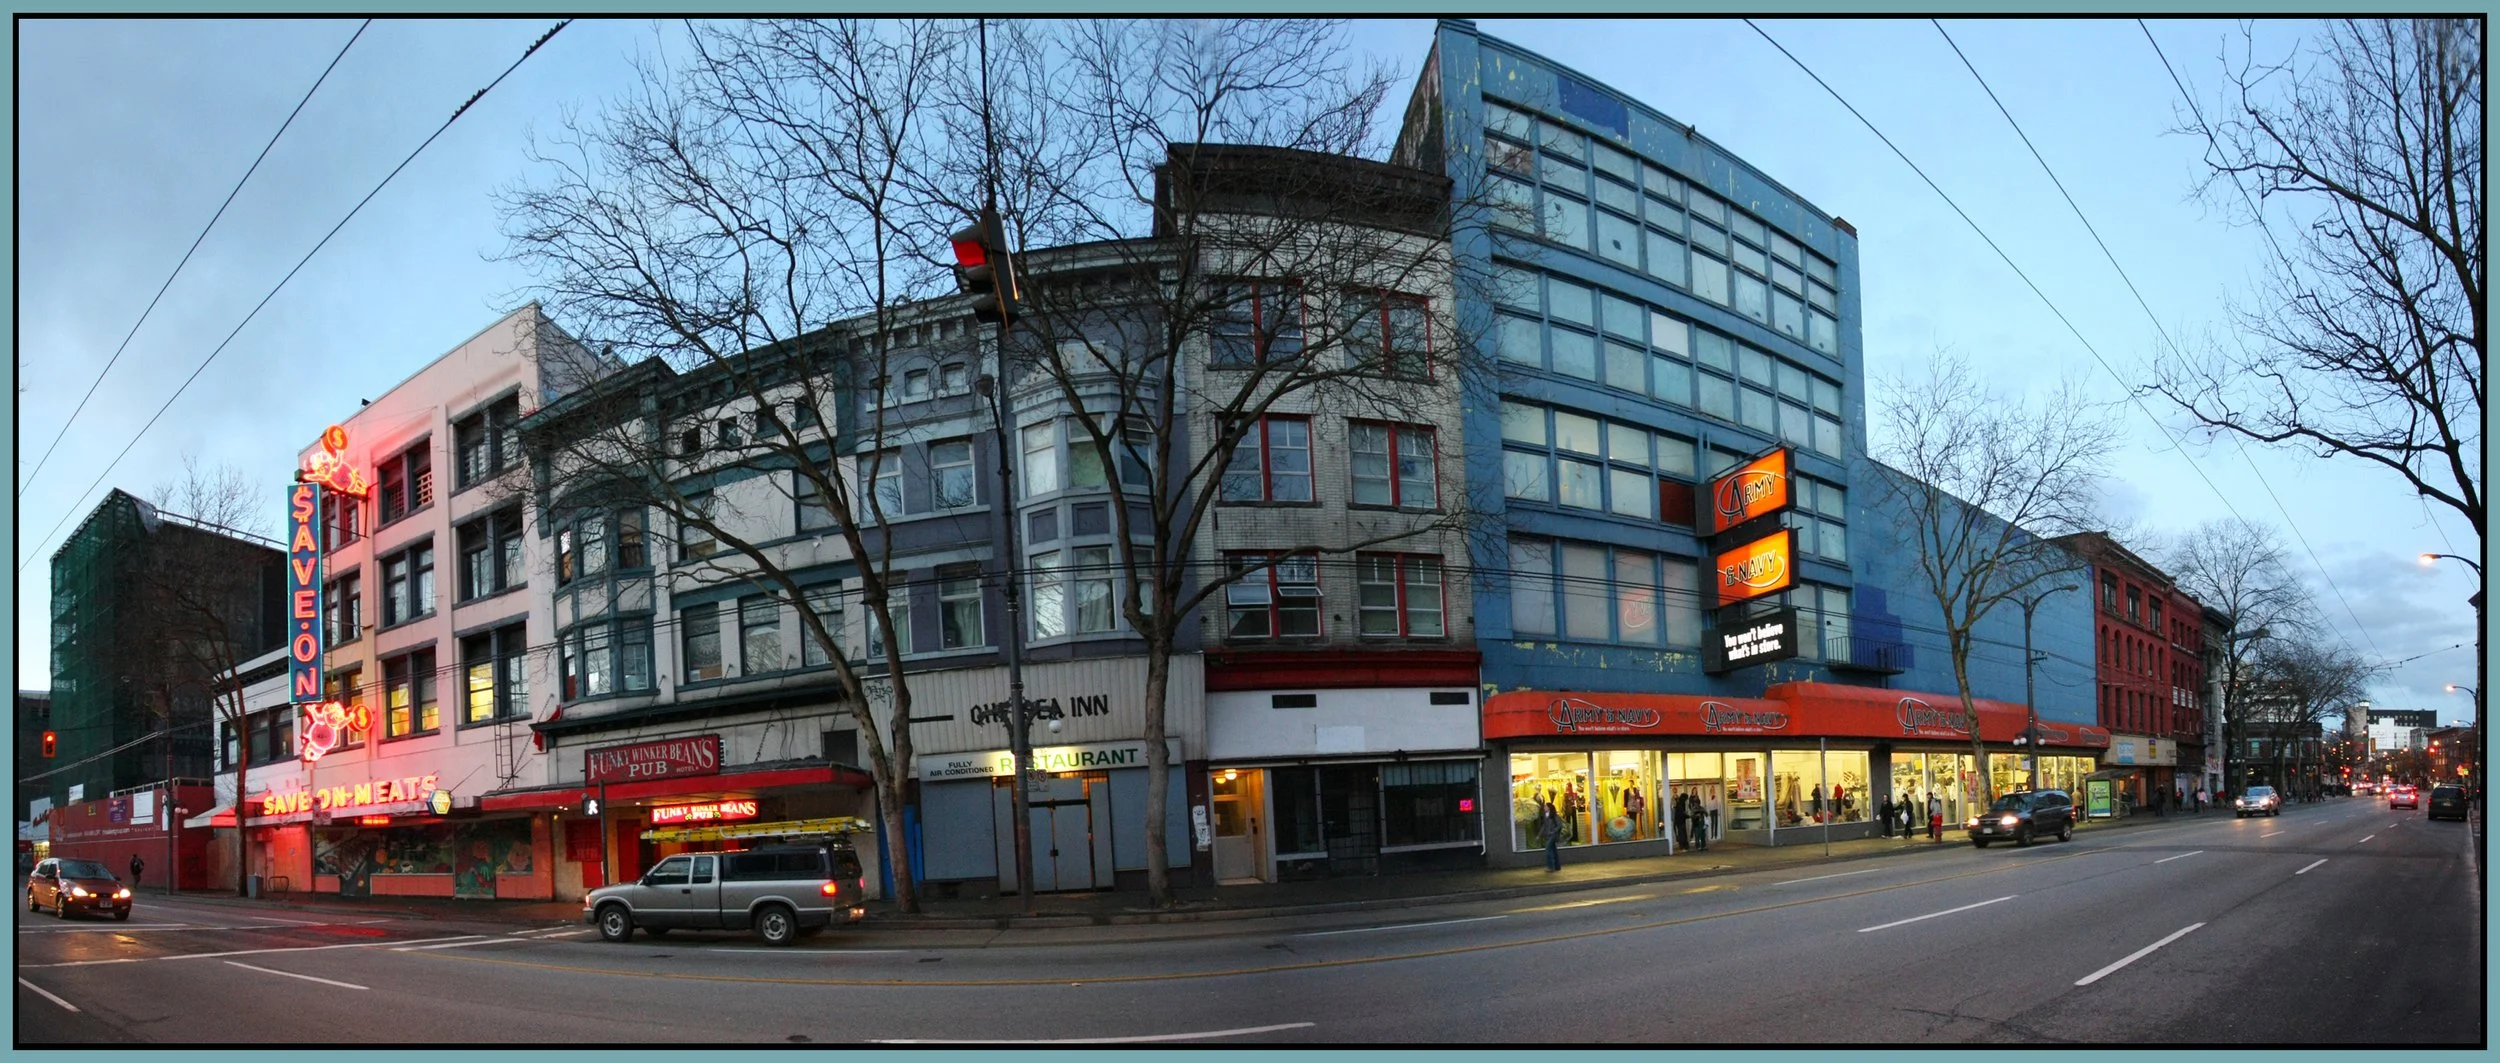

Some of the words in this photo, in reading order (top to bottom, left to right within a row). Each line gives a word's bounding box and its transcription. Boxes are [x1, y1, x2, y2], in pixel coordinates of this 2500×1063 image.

[1738, 549, 1777, 583] NAVY
[1724, 634, 1737, 648] You
[1737, 627, 1757, 645] won't
[1757, 623, 1784, 640] believe
[1728, 643, 1751, 661] what's
[1750, 641, 1759, 656] in
[1759, 639, 1782, 654] store.
[1070, 694, 1109, 717] INN
[1558, 700, 1603, 732] ARMY
[1618, 708, 1651, 723] NAVY
[1706, 703, 1742, 732] ARMY
[1904, 700, 1939, 736] ARMY
[590, 749, 630, 780] FUNKY
[632, 744, 668, 762] WINKER
[628, 761, 668, 778] PUB
[944, 766, 995, 776] CONDITIONED
[653, 807, 689, 822] FUNKY
[691, 804, 719, 812] WINKER
[693, 811, 715, 820] PUB
